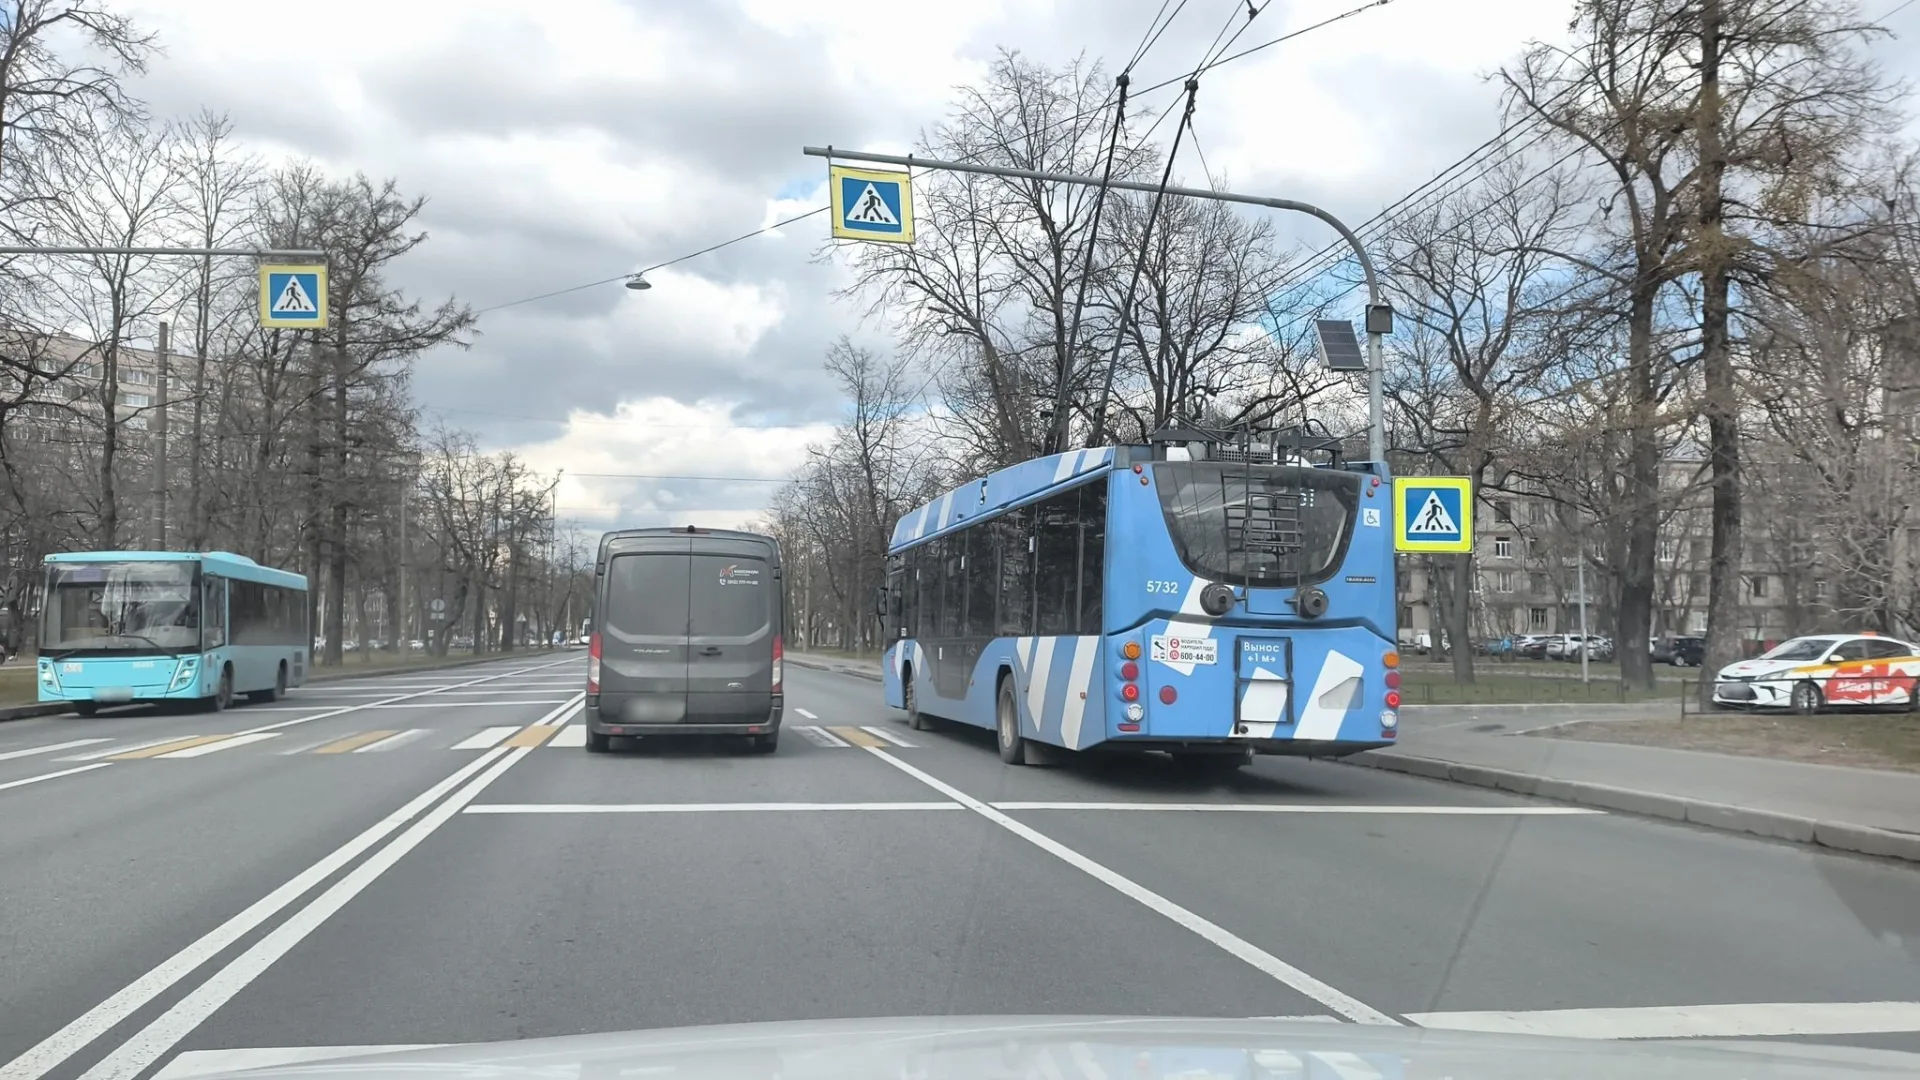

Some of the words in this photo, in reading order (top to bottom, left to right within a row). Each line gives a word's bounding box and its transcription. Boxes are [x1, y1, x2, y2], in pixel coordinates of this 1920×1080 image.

[1146, 580, 1179, 594] 5732
[1244, 641, 1280, 652] Вынос
[1180, 651, 1215, 662] 600-44-00
[1254, 652, 1259, 662] 1
